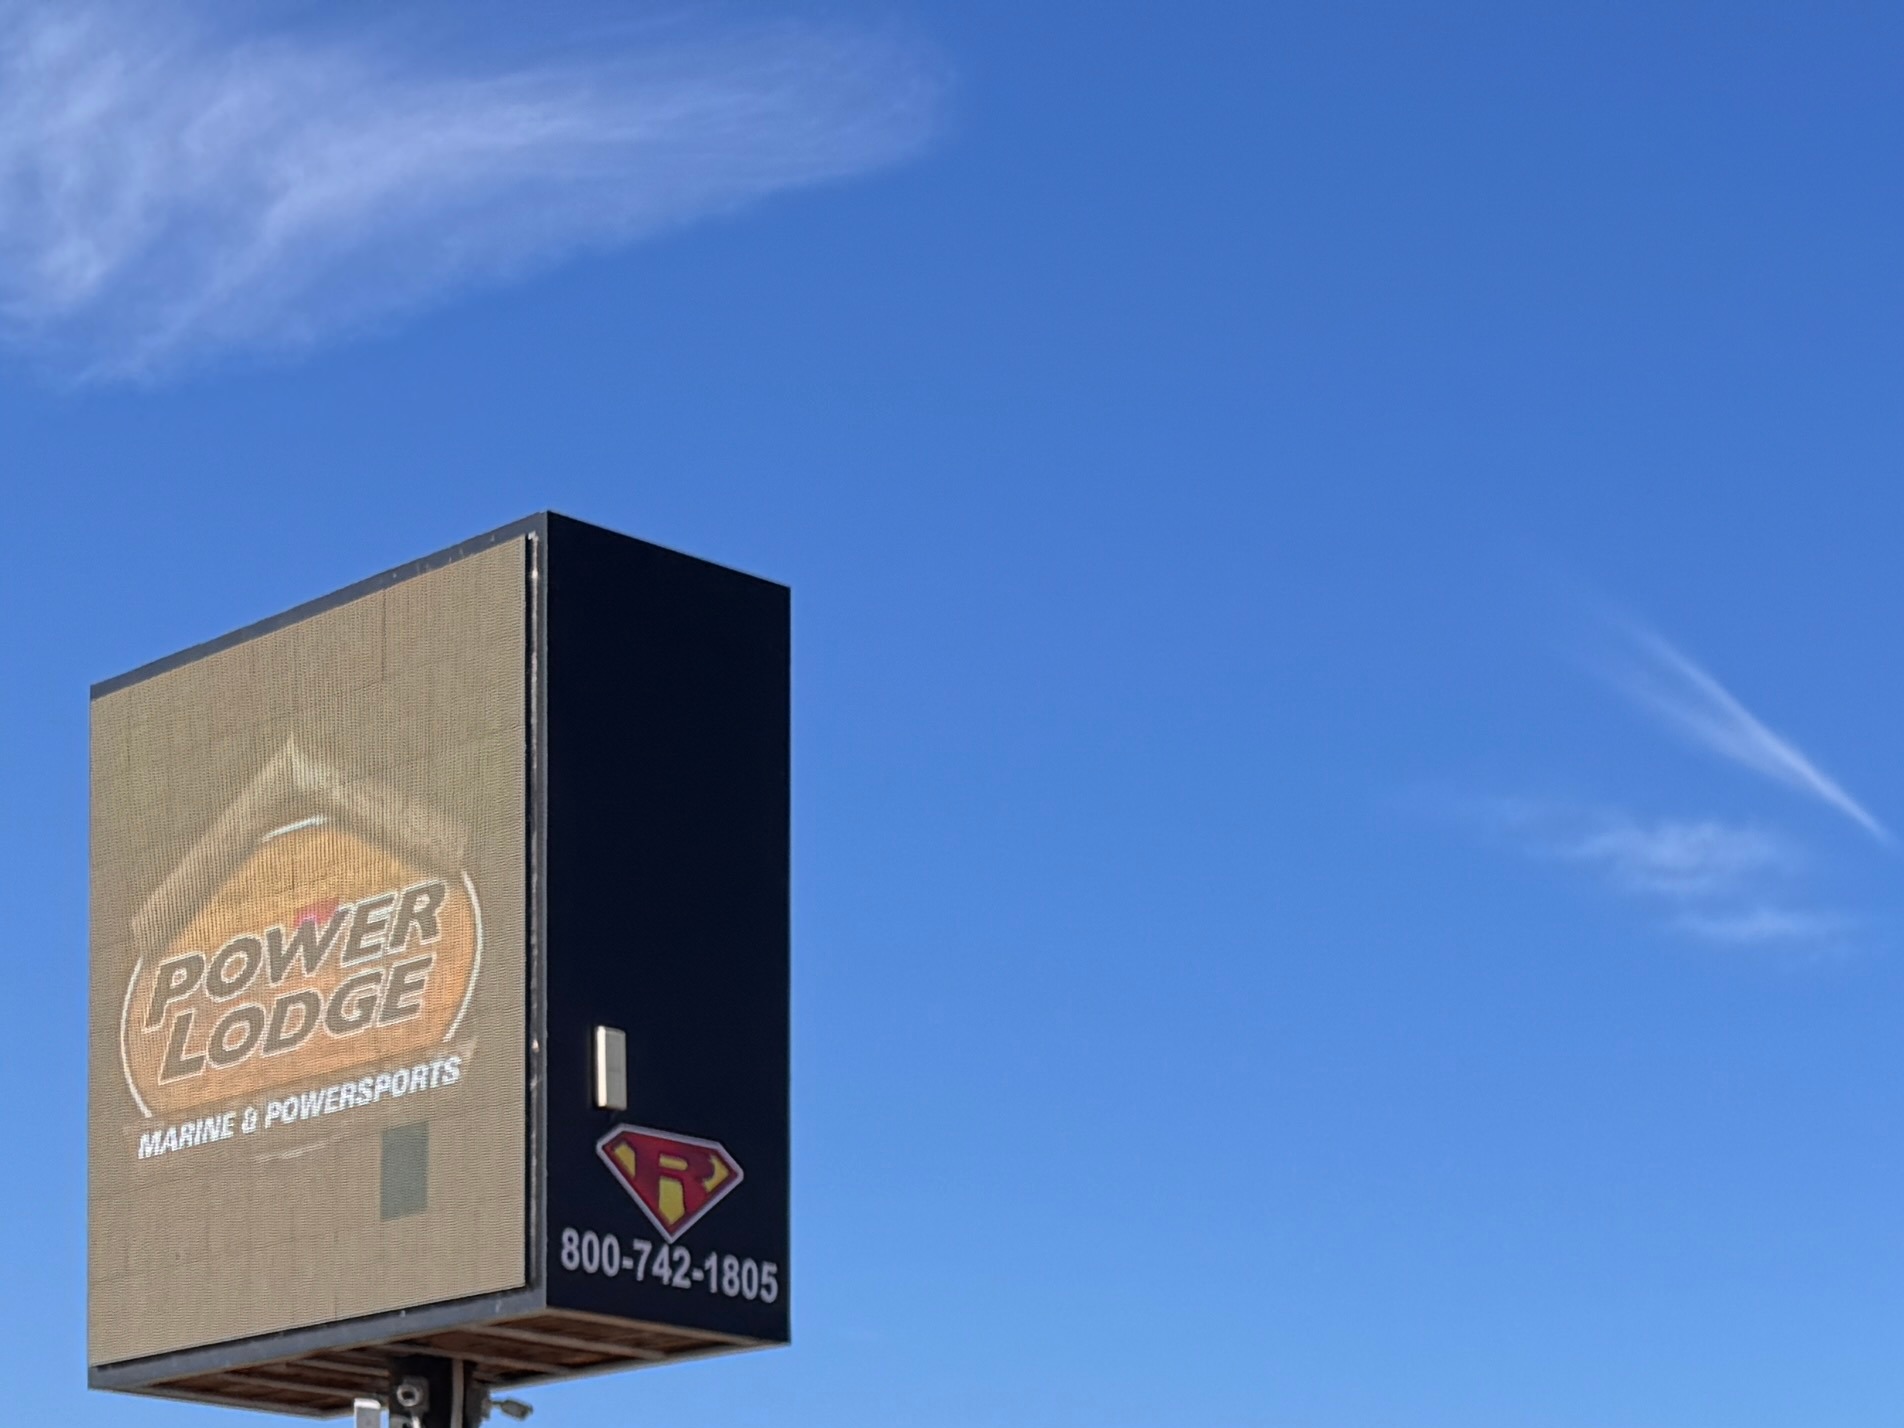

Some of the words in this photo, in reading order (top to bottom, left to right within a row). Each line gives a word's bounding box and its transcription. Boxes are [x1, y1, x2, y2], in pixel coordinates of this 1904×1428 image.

[141, 879, 449, 1034] POWER
[158, 951, 437, 1085] LODGE
[138, 1113, 236, 1159] MARINE
[241, 1107, 257, 1134] &
[265, 1055, 462, 1129] POWERSPORTS
[561, 1227, 778, 1303] 800-742-1805
